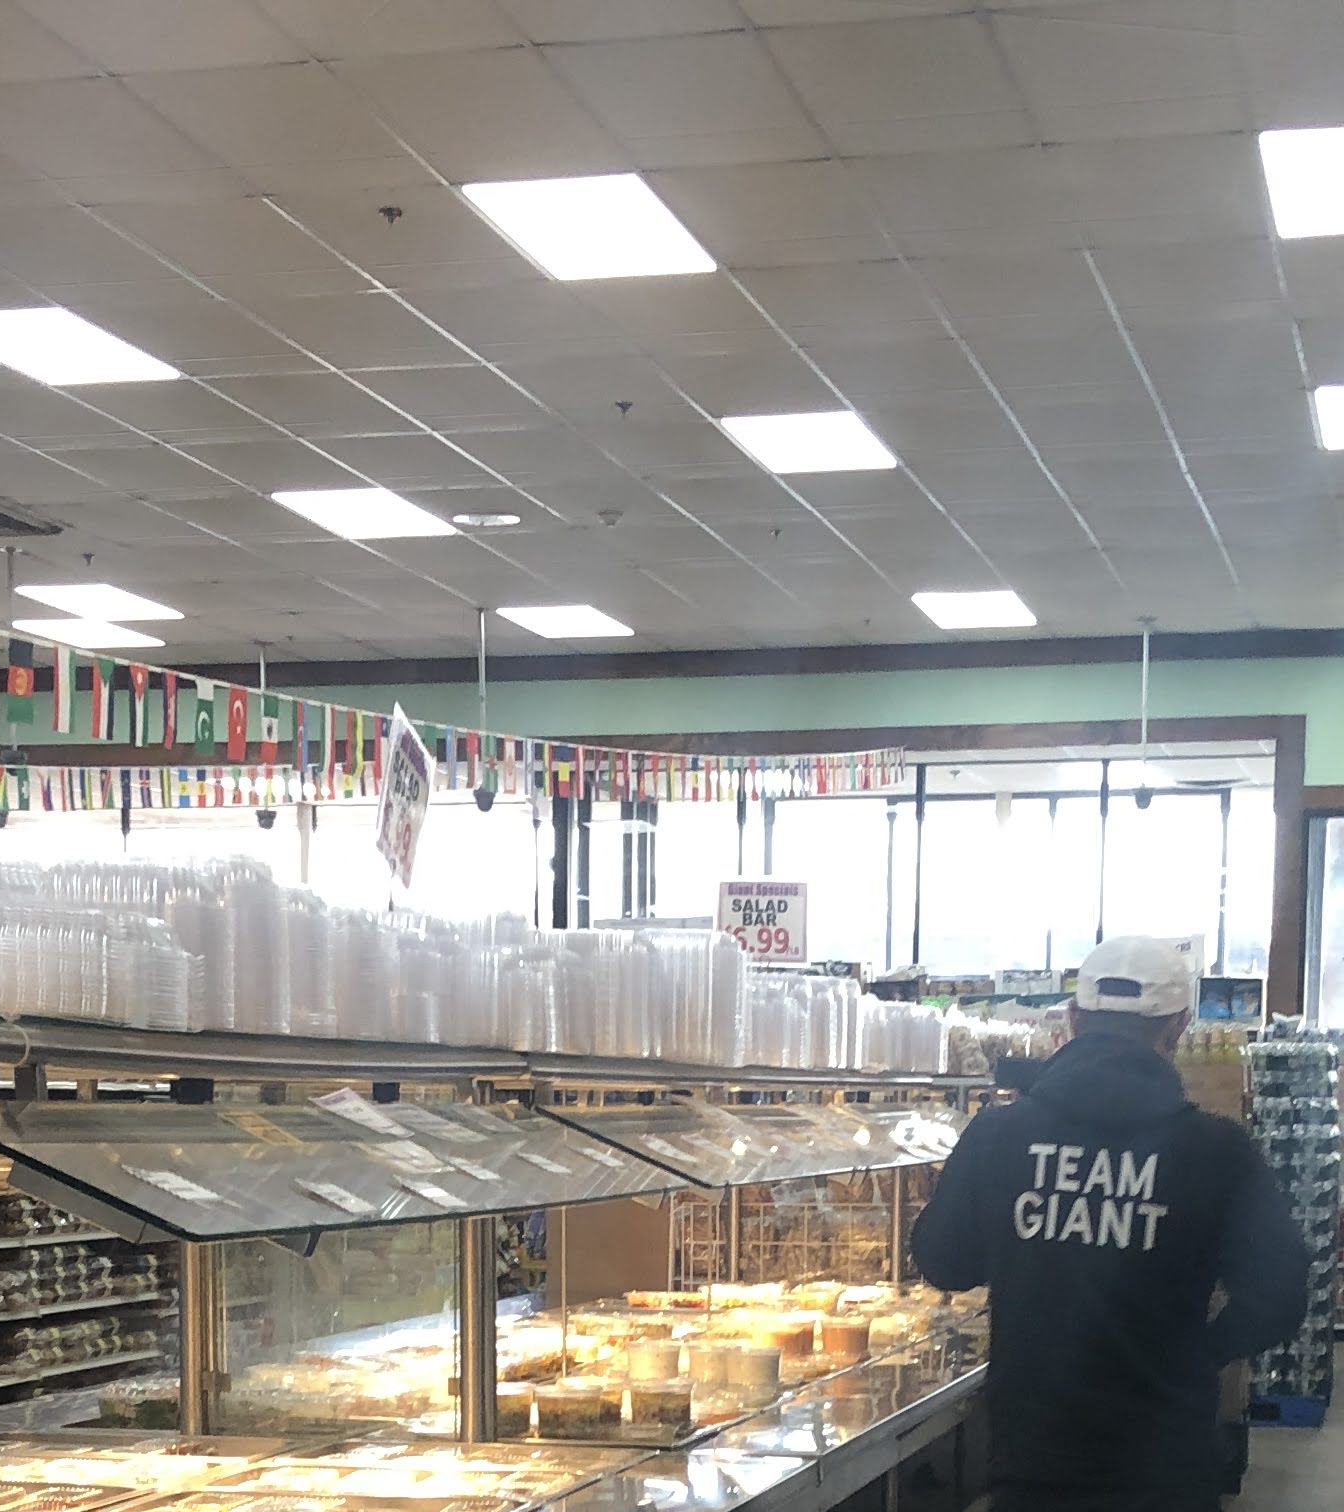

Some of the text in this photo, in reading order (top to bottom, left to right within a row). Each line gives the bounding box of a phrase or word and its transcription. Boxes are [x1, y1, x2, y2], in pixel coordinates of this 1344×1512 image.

[731, 898, 789, 913] SALAD
[742, 911, 777, 926] BAR
[1027, 1143, 1160, 1200] TEAM
[1012, 1192, 1168, 1252] GIANT
